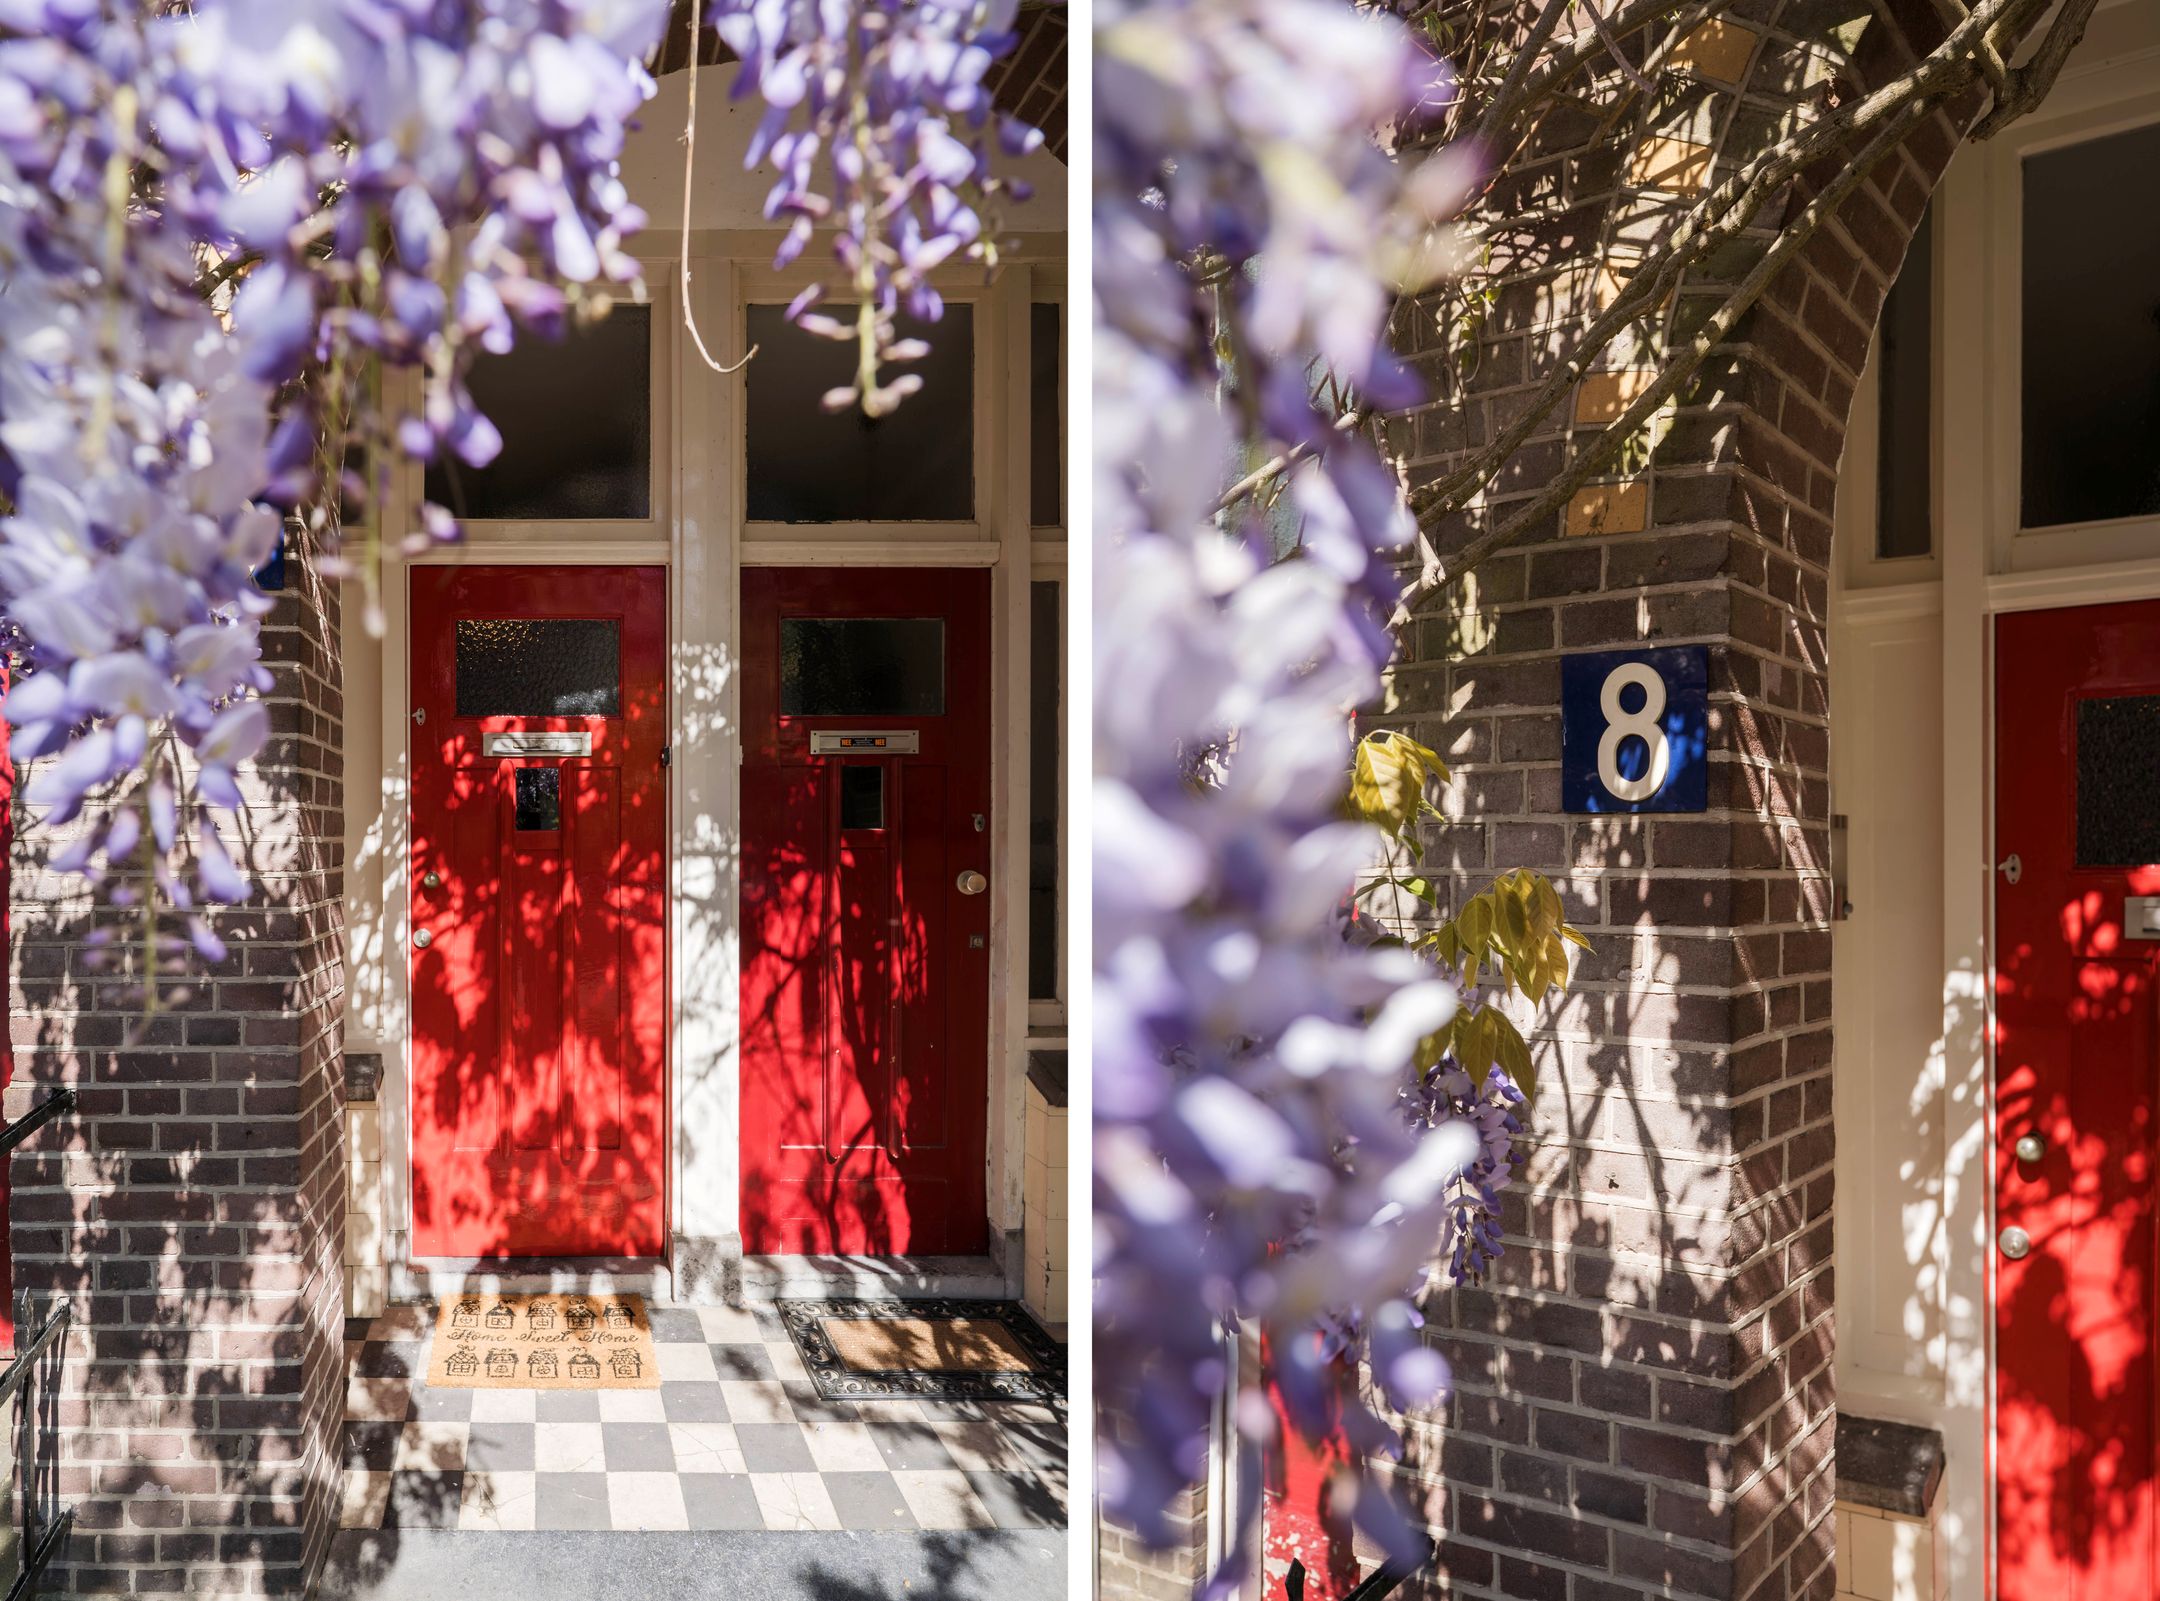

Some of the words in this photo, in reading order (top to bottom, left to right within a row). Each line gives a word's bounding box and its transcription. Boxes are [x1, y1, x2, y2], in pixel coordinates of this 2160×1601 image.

[1598, 662, 1670, 802] 8
[447, 1328, 507, 1343] Home
[515, 1330, 576, 1343] Sweet
[578, 1329, 639, 1344] Home
